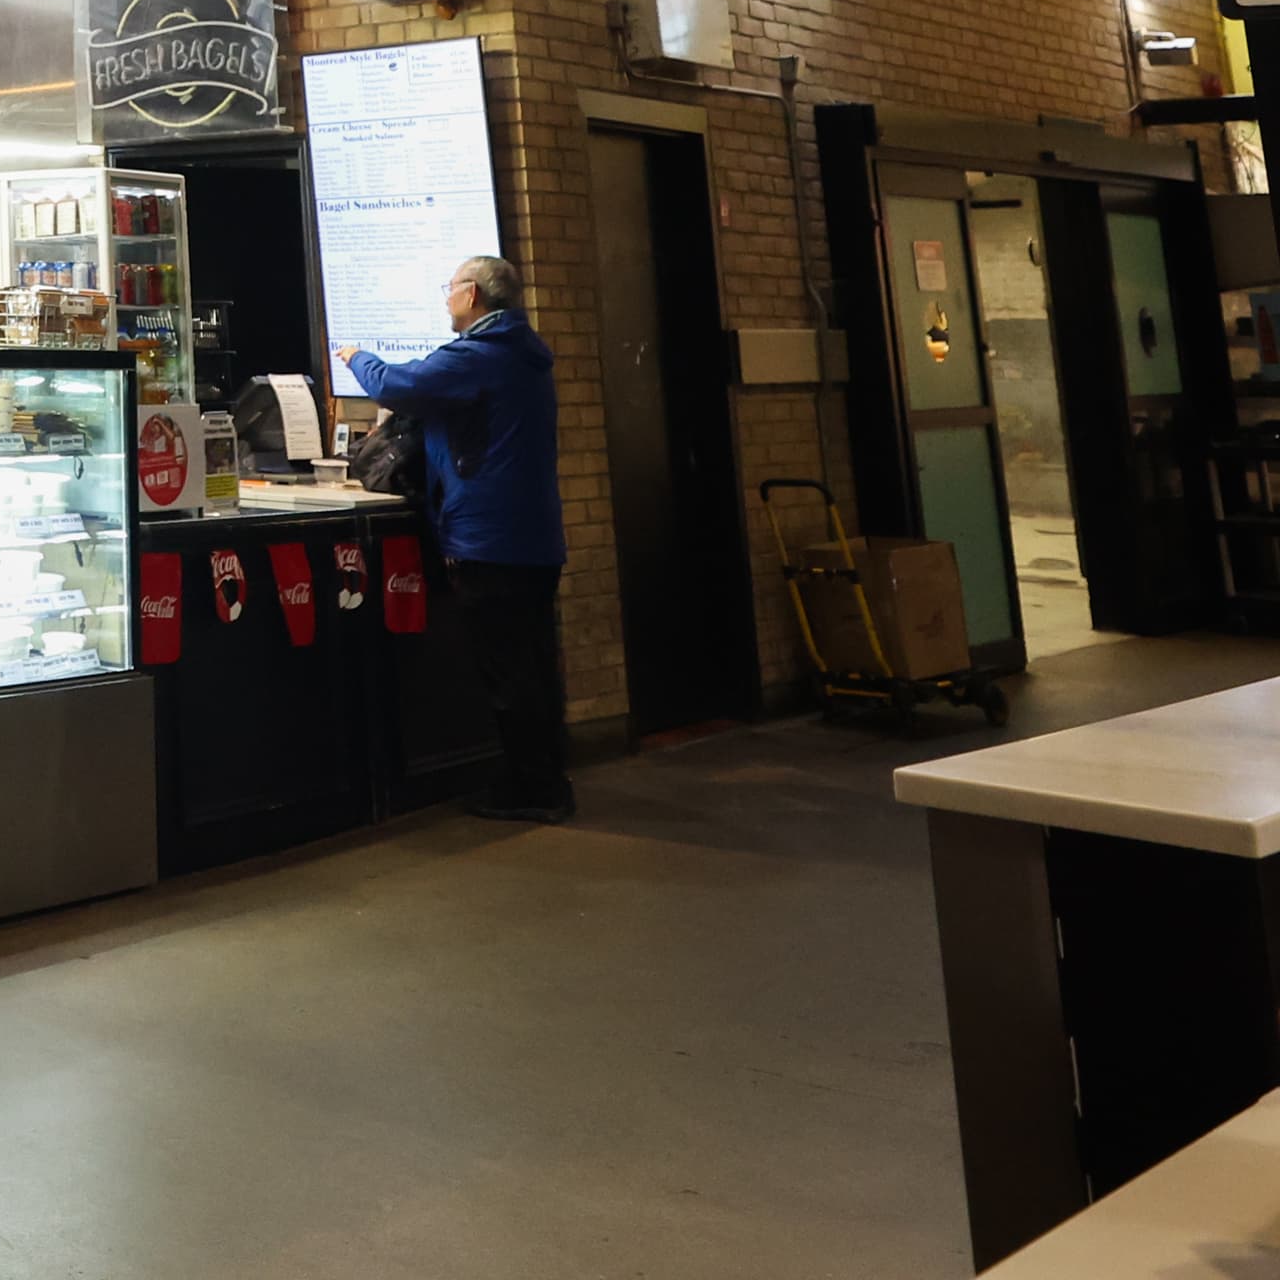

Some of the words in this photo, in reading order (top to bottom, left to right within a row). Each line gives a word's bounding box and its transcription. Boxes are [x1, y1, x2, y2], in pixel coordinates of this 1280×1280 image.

[95, 43, 164, 91] FRESH
[171, 37, 266, 82] BAGELS
[306, 51, 347, 67] Montreal
[349, 51, 372, 64] Style
[375, 49, 406, 63] Bagels
[311, 123, 340, 134] Cream
[341, 121, 373, 132] Cheese
[319, 200, 351, 214] Bagel
[353, 197, 422, 211] Sandwiches
